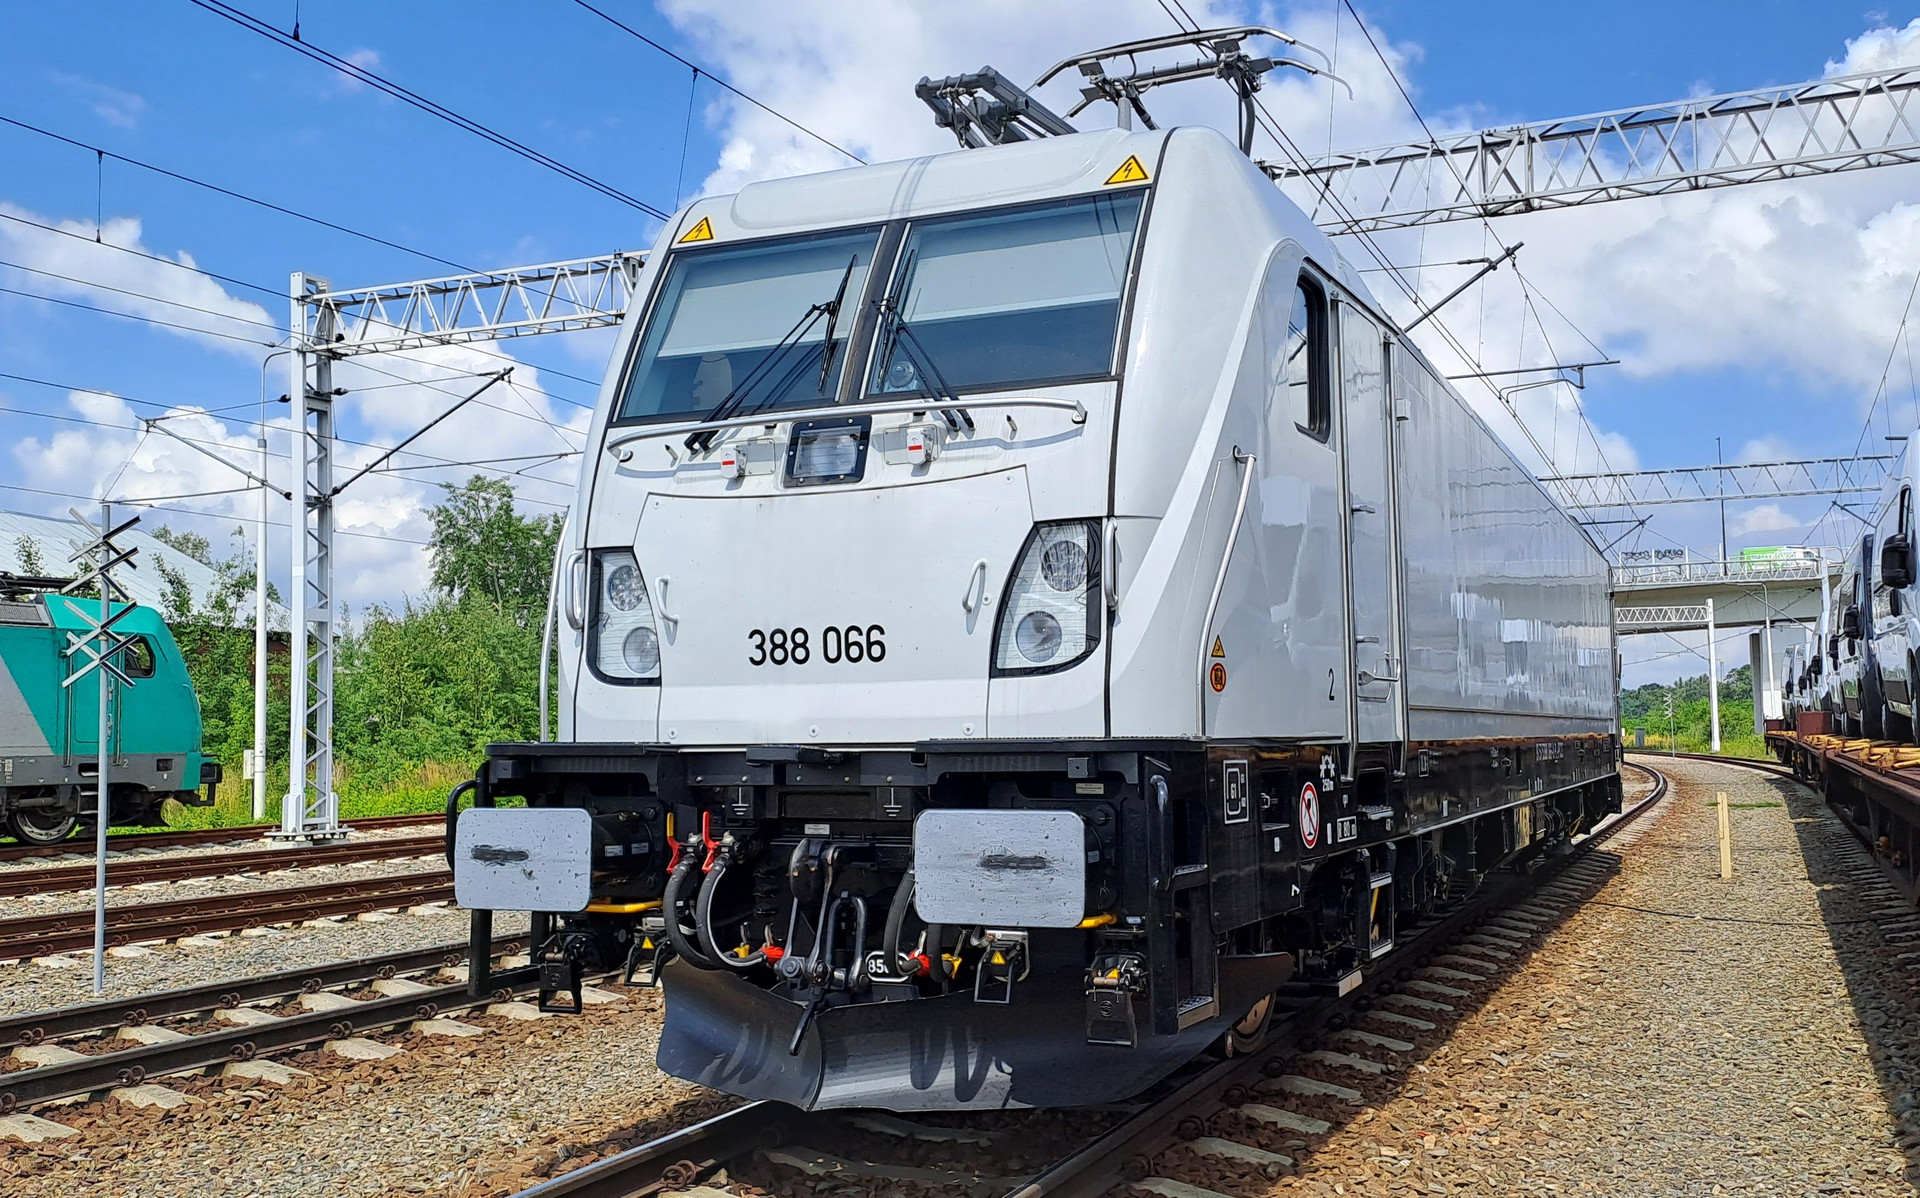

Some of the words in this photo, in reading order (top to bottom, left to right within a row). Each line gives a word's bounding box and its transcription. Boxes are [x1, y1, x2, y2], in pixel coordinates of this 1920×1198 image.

[748, 628, 810, 666] 388
[822, 624, 886, 664] 066
[1328, 668, 1335, 701] 2
[123, 759, 129, 768] 2
[868, 959, 889, 974] 85
